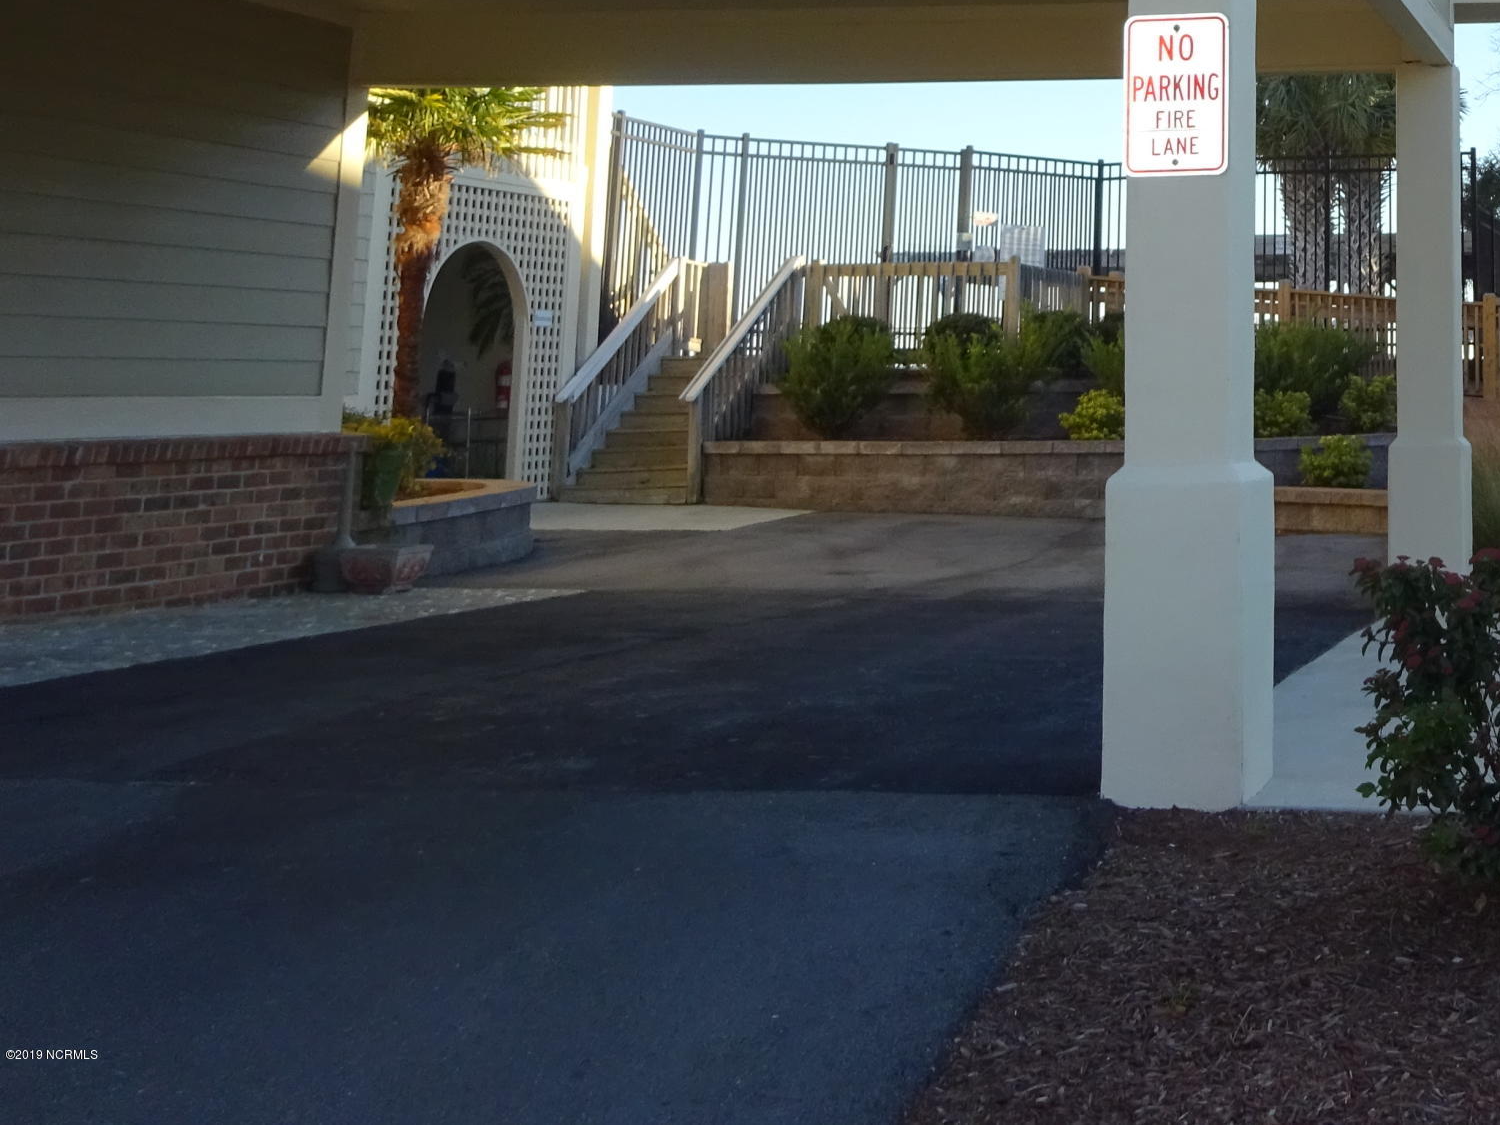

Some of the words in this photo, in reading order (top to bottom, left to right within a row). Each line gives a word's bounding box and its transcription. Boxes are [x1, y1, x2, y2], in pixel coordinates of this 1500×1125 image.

[1158, 33, 1194, 61] NO
[1132, 72, 1219, 102] PARKING
[1155, 109, 1196, 129] FIRE
[1151, 136, 1199, 156] LANE
